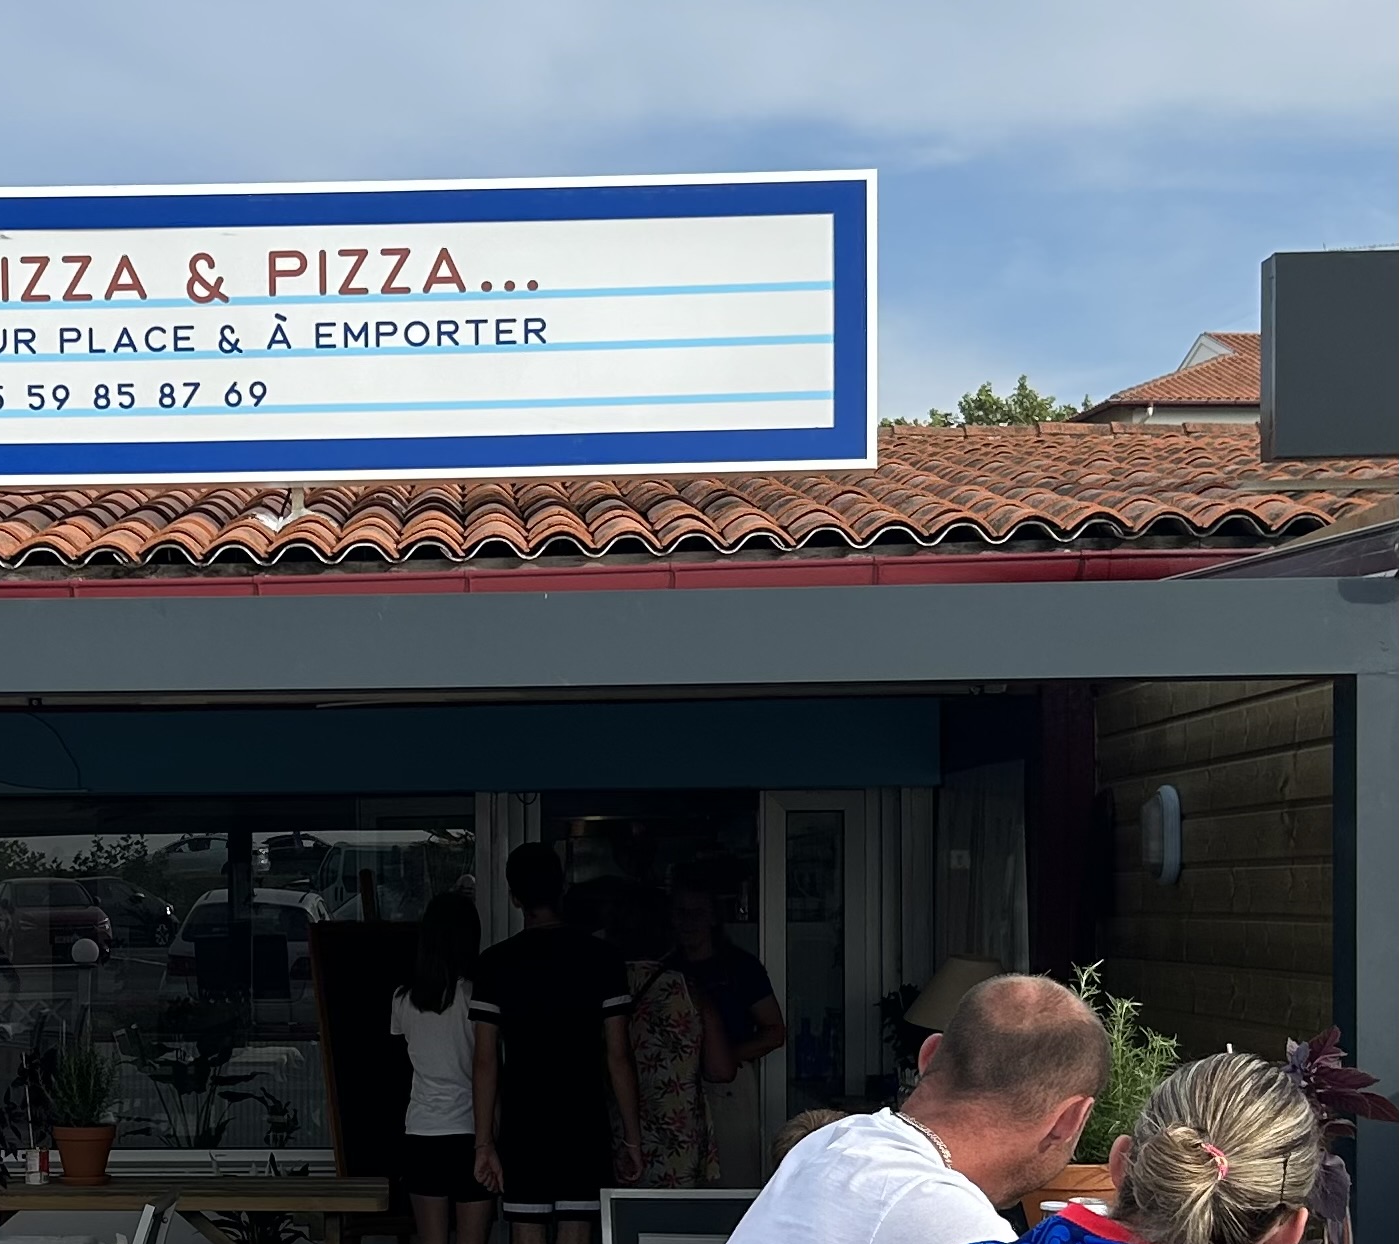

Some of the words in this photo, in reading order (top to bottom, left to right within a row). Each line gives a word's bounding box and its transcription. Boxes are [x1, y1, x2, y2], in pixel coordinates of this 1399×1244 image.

[186, 252, 230, 304] &
[268, 247, 539, 297] PIZZA...
[59, 325, 195, 354] PLACE
[218, 324, 243, 354] &
[266, 312, 292, 350] À
[314, 317, 547, 349] EMPORTER
[27, 384, 70, 411] 59
[93, 383, 135, 410] 85
[158, 382, 201, 409] 87
[224, 381, 267, 408] 69
